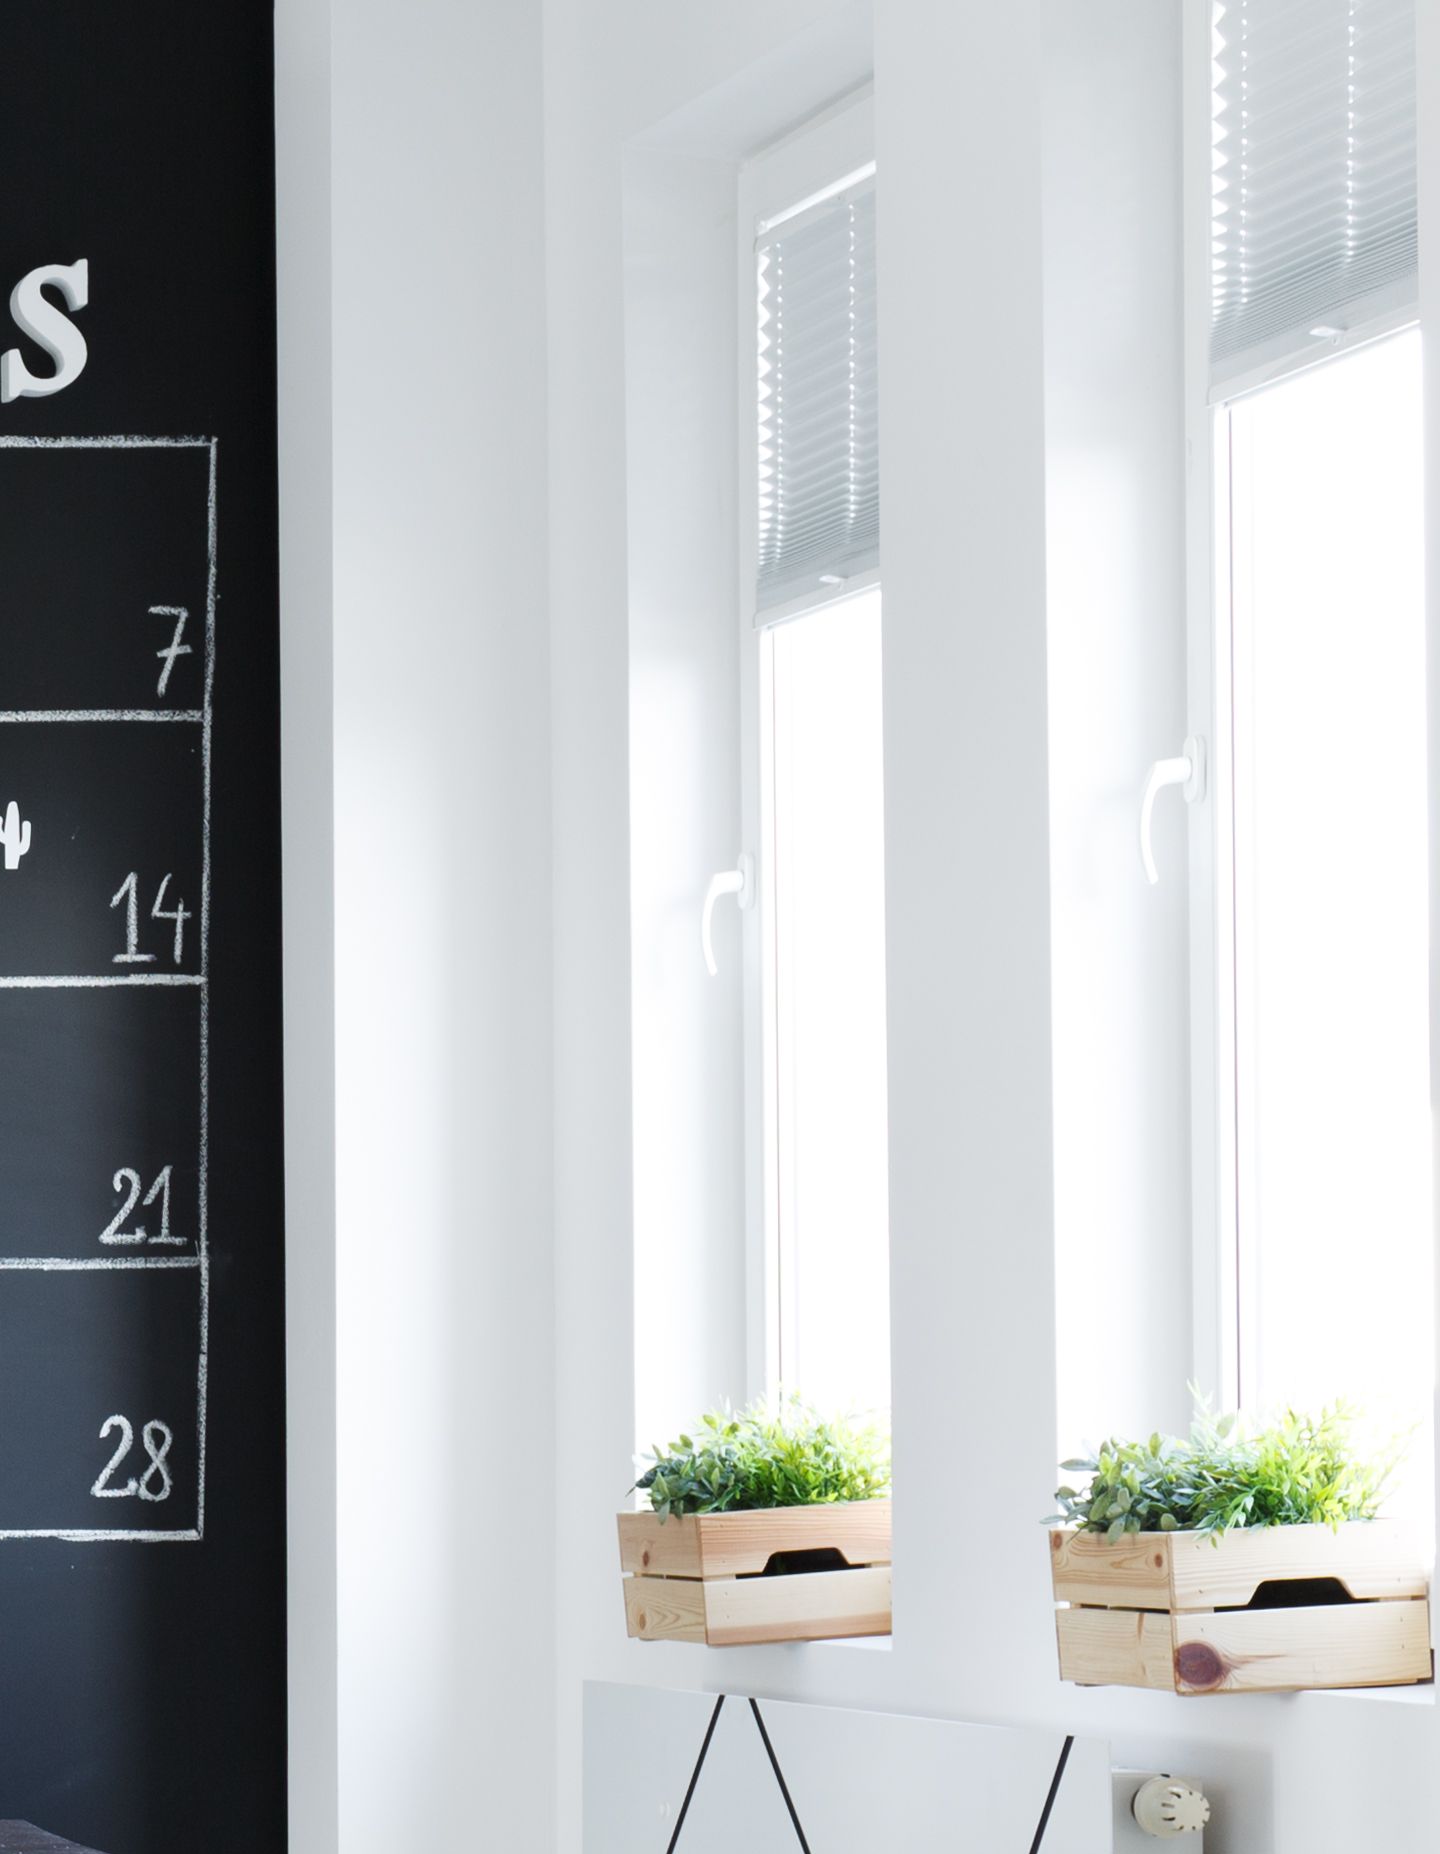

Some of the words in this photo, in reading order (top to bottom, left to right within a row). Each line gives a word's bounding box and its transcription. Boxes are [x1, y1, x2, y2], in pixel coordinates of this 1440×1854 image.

[149, 606, 192, 695] 7
[110, 872, 191, 964] 14
[98, 1166, 187, 1245] 21
[90, 1414, 173, 1501] 28
